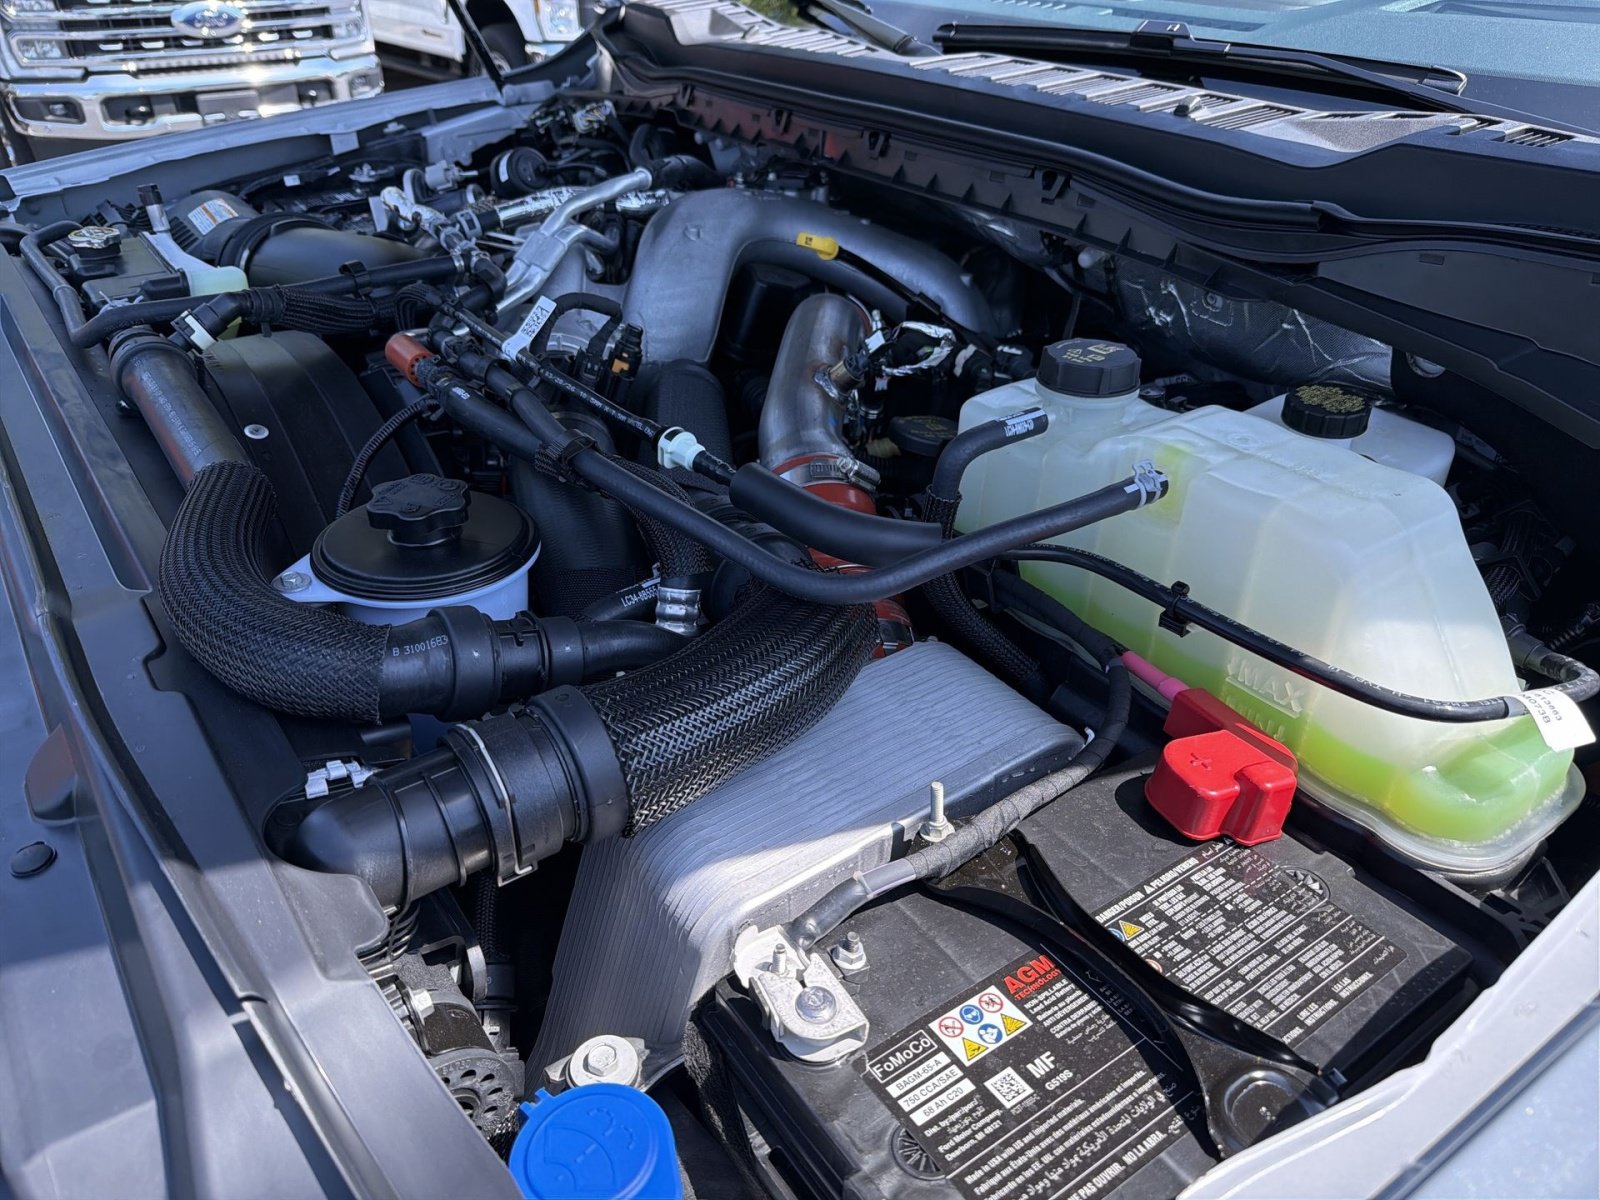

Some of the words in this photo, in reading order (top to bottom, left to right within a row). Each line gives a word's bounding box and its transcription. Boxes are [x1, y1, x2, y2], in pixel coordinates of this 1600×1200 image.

[1004, 955, 1054, 994] AGM
[1024, 978, 1068, 1009] NON-SPILLABLE
[1029, 1002, 1045, 1015] Lead
[1043, 994, 1057, 1006] Acid
[1054, 983, 1076, 998] Battery
[1036, 1005, 1059, 1021] Batterie
[1064, 990, 1083, 1004] plomb
[1043, 1016, 1057, 1027] ANTI
[1049, 1017, 1073, 1034] CONTRA
[872, 1037, 931, 1078] FoMoCo
[1026, 1051, 1055, 1078] MF
[895, 1059, 942, 1091] BAGM-65-A
[903, 1093, 921, 1107] 750
[919, 1069, 958, 1097] CCA/SAE
[1045, 1069, 1073, 1091] G519S
[922, 1106, 935, 1117] 68
[934, 1099, 948, 1110] Ah
[946, 1086, 964, 1101] C20
[923, 1125, 941, 1137] Dist.
[937, 1139, 956, 1153] Ford
[952, 1128, 973, 1143] Motor
[973, 1173, 1003, 1196] Fabriqué
[1000, 1165, 1014, 1177] aux
[1039, 1135, 1055, 1149] avec
[1052, 1128, 1065, 1139] des
[1115, 1085, 1124, 1094] et
[974, 1131, 986, 1141] MI
[964, 1169, 985, 1185] Made
[980, 1164, 992, 1173] in
[987, 1155, 1003, 1168] USA
[1000, 1146, 1016, 1159] with
[1012, 1139, 1025, 1150] US
[1021, 1131, 1036, 1144] and
[1031, 1114, 1059, 1136] imported
[1077, 1182, 1097, 1199] PAS
[1122, 1151, 1138, 1165] NO
[1132, 1144, 1148, 1157] LA
[1142, 1130, 1167, 1150] ABRA.
